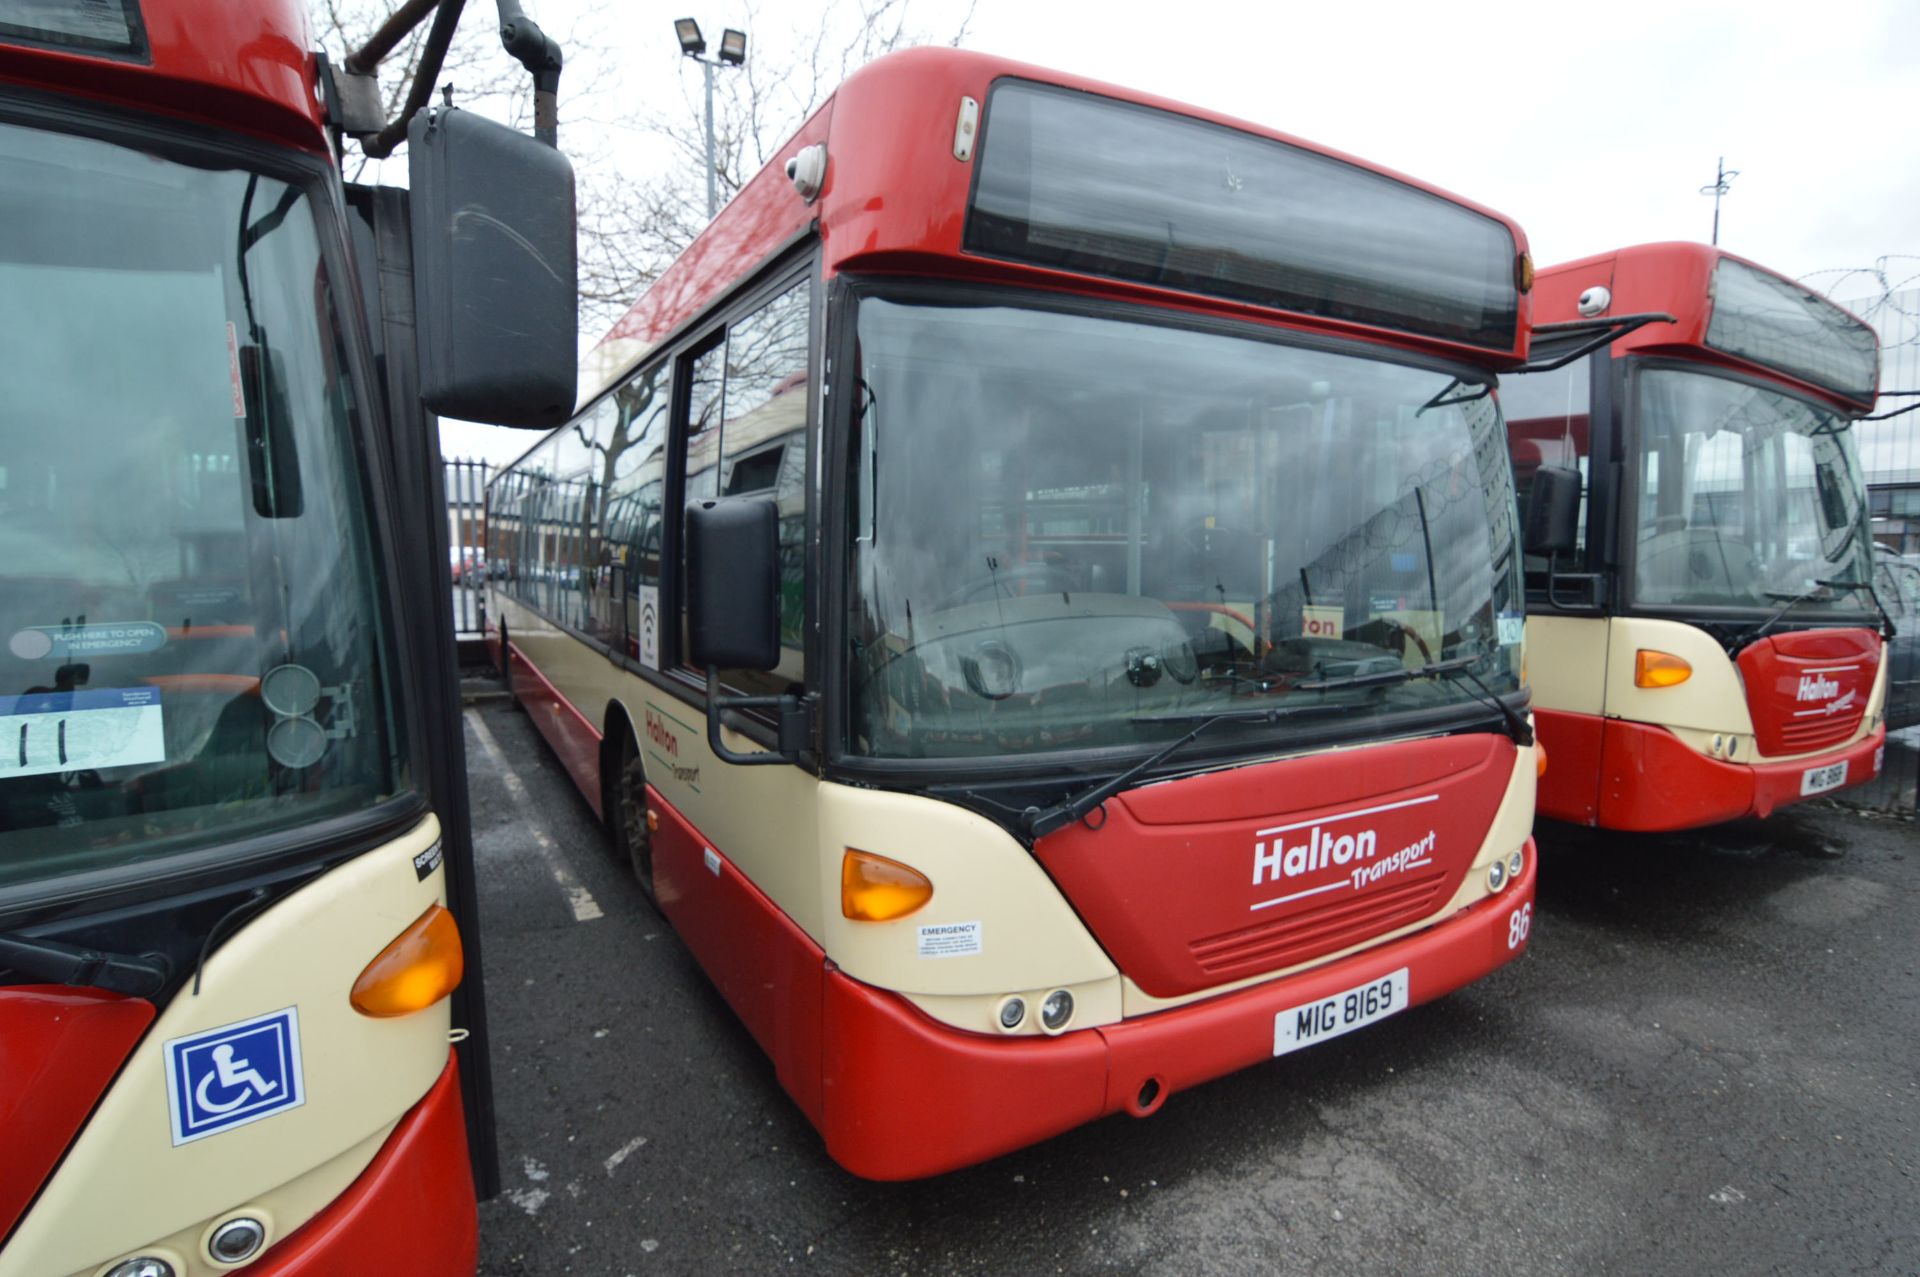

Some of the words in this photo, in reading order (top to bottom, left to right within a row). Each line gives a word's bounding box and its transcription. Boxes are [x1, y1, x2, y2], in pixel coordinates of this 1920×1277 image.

[53, 632, 82, 642] PUSH
[84, 630, 108, 641] HERE
[110, 629, 125, 639] TO
[127, 627, 156, 638] OPEN
[68, 640, 80, 650] IN
[81, 638, 143, 650] EMERGENCY
[645, 710, 679, 757] Halton
[1252, 826, 1377, 886] Halton
[1350, 829, 1436, 890] Transport
[921, 924, 977, 936] EMERGENCY
[1508, 901, 1531, 950] 86
[1296, 1001, 1336, 1041] MIG
[1344, 979, 1392, 1025] 8169
